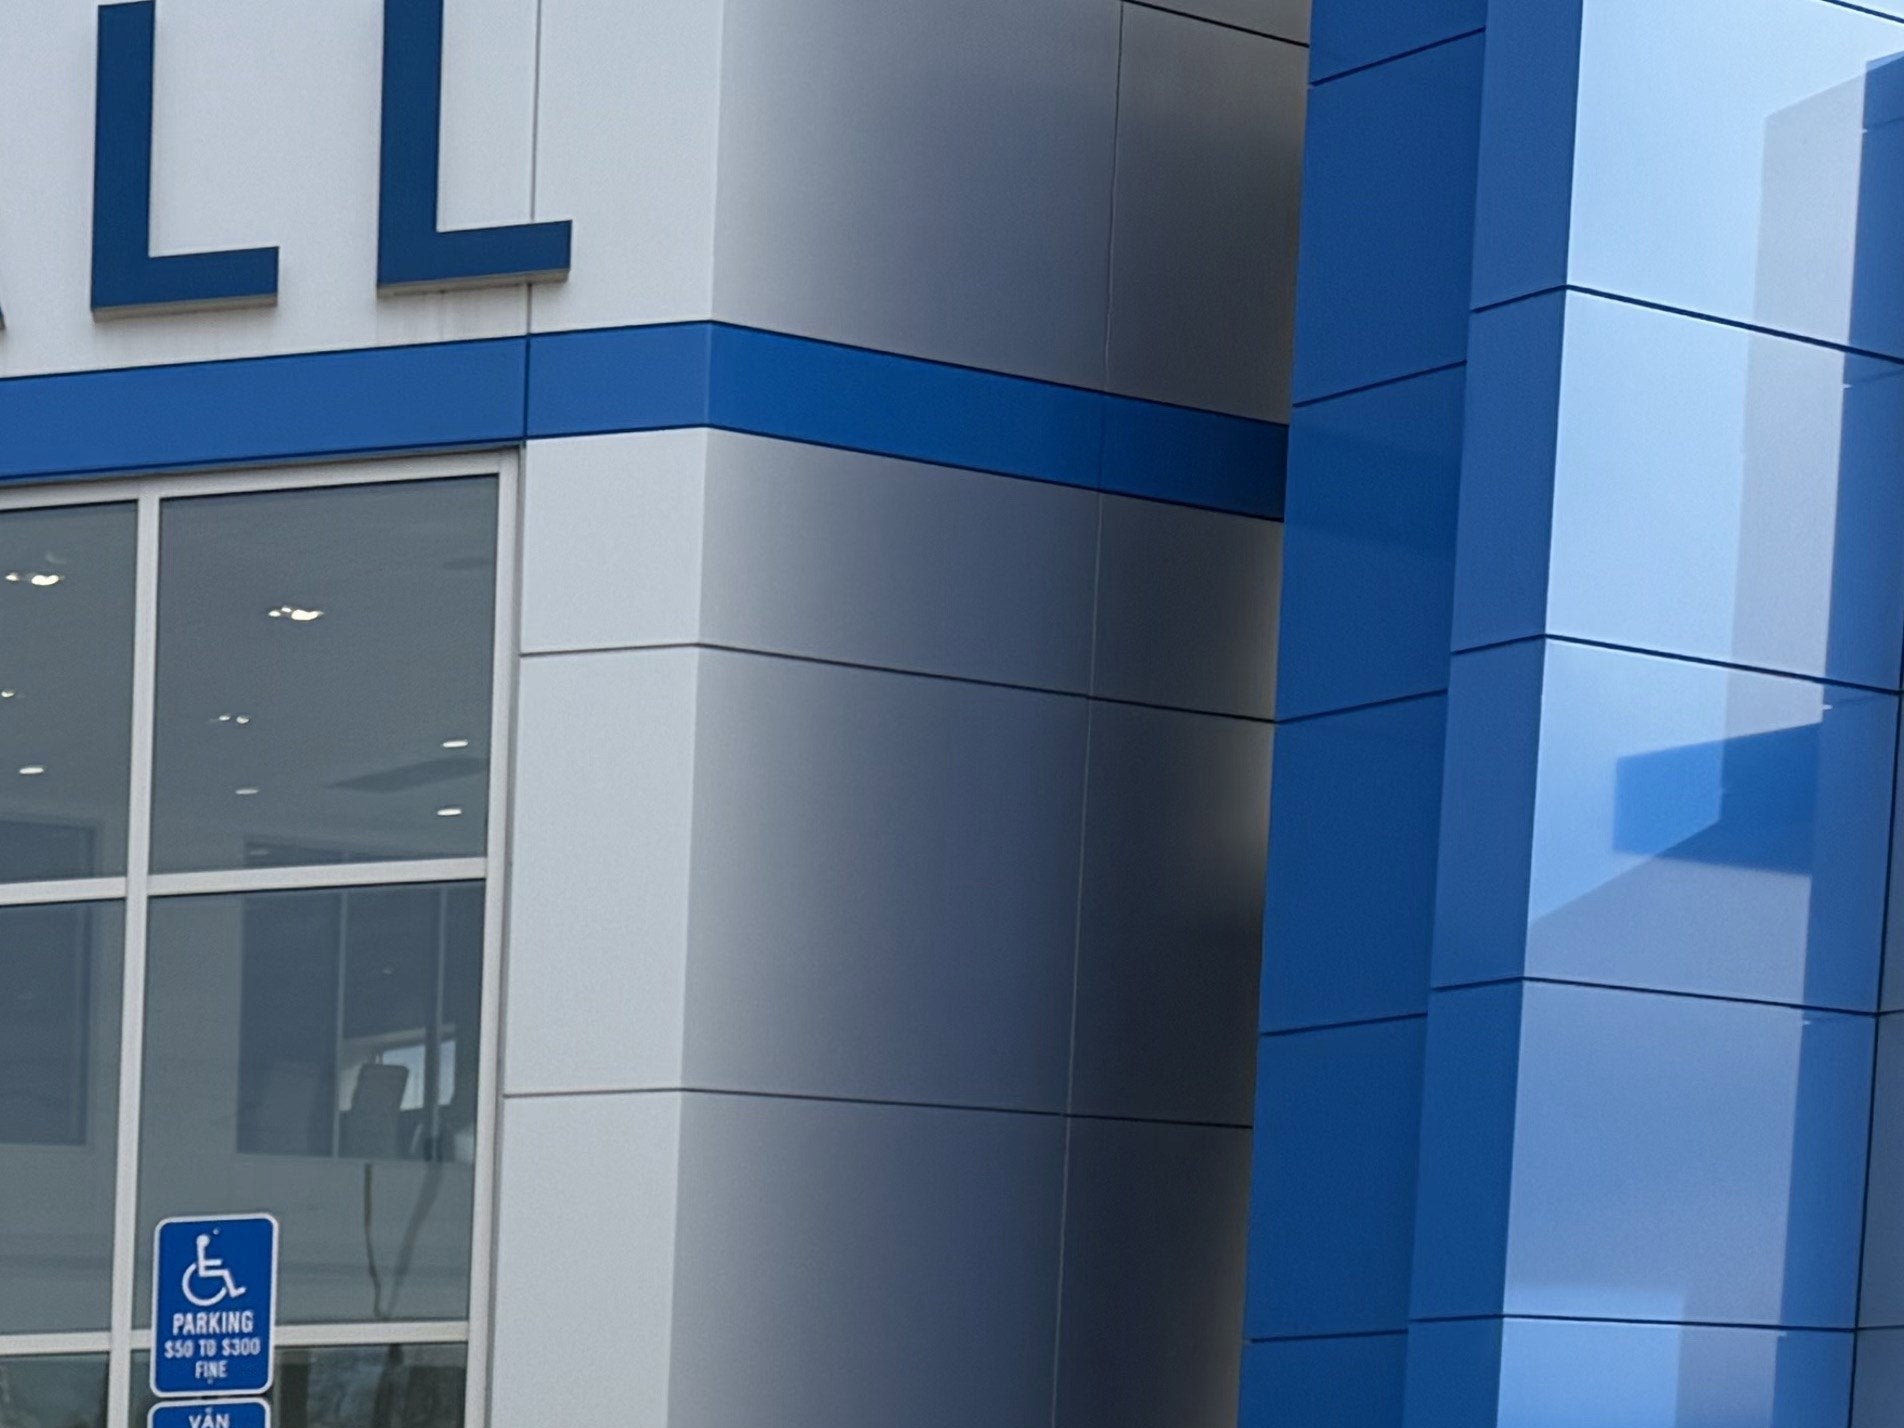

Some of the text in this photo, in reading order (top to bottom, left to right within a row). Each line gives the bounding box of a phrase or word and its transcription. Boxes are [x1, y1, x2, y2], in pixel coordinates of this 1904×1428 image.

[172, 1310, 254, 1336] PARKING
[164, 1337, 261, 1359] $50 TO $300
[195, 1360, 229, 1380] FINE
